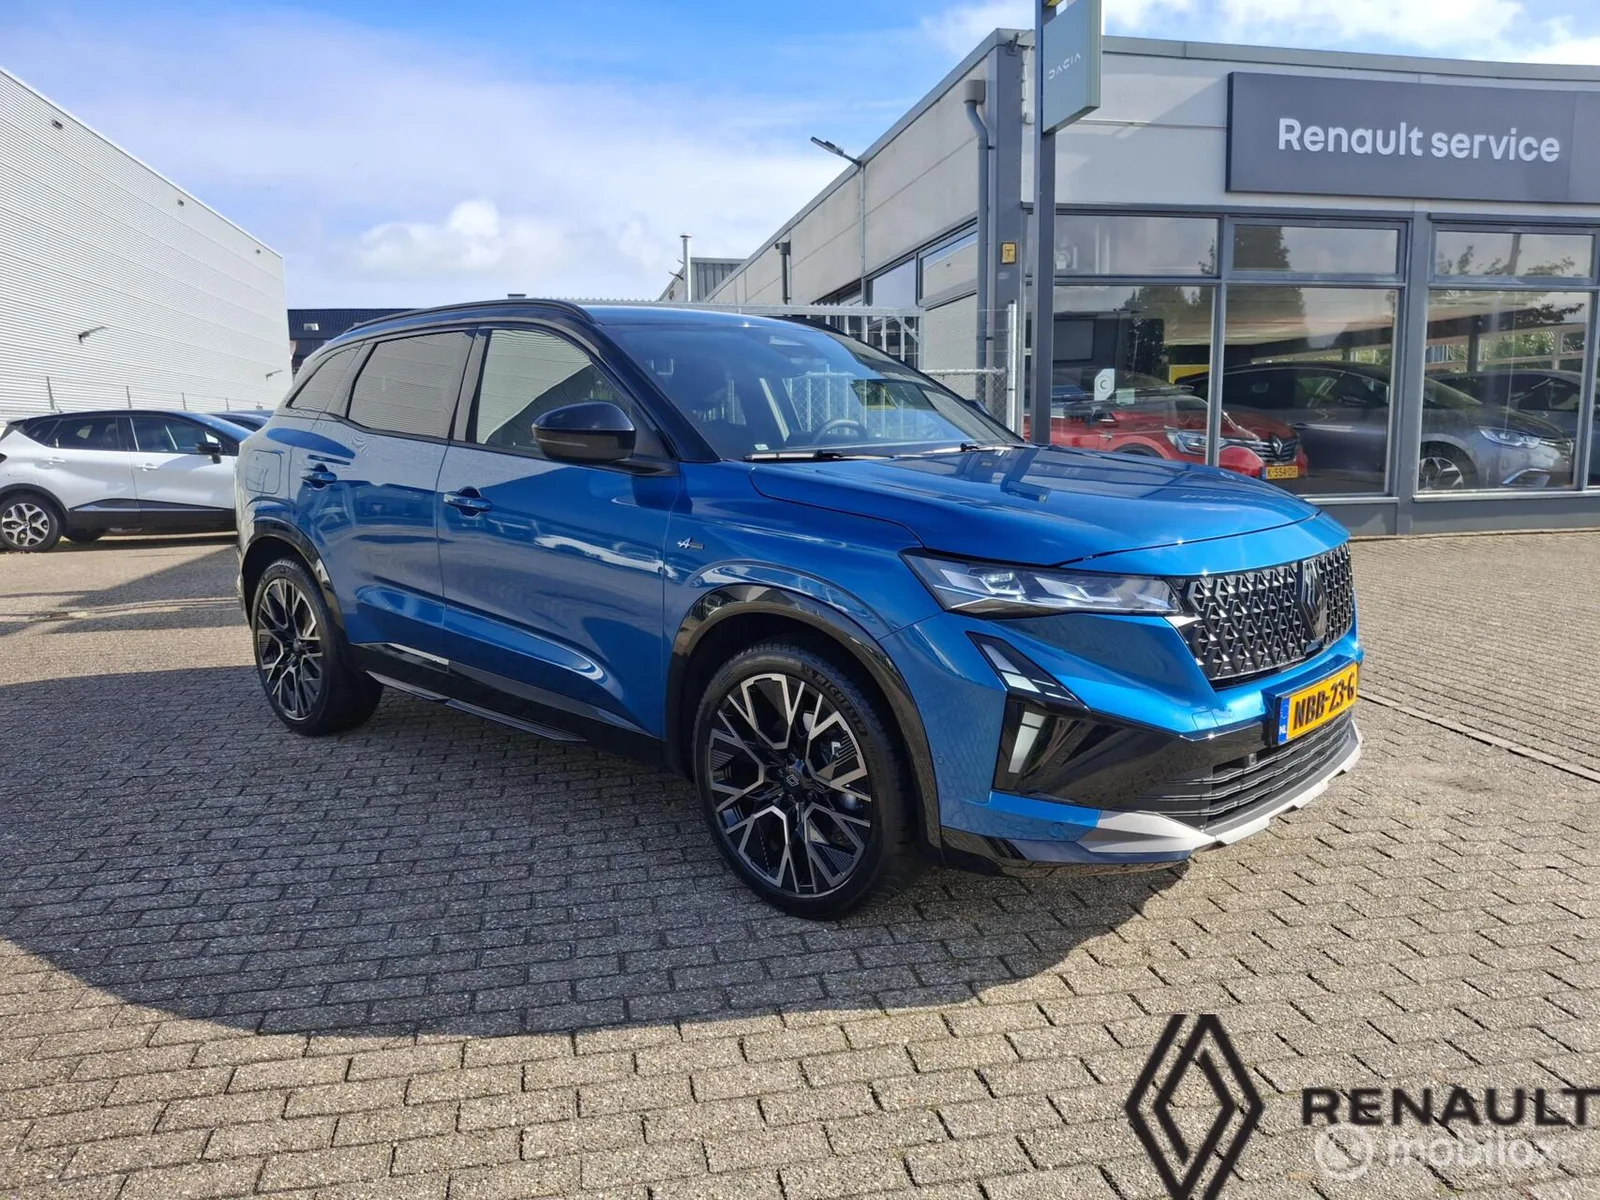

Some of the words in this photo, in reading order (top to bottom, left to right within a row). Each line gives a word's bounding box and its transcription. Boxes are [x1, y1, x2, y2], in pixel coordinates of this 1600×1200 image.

[1048, 52, 1081, 80] DACIA
[1278, 117, 1423, 156] Renault
[1430, 127, 1560, 162] service
